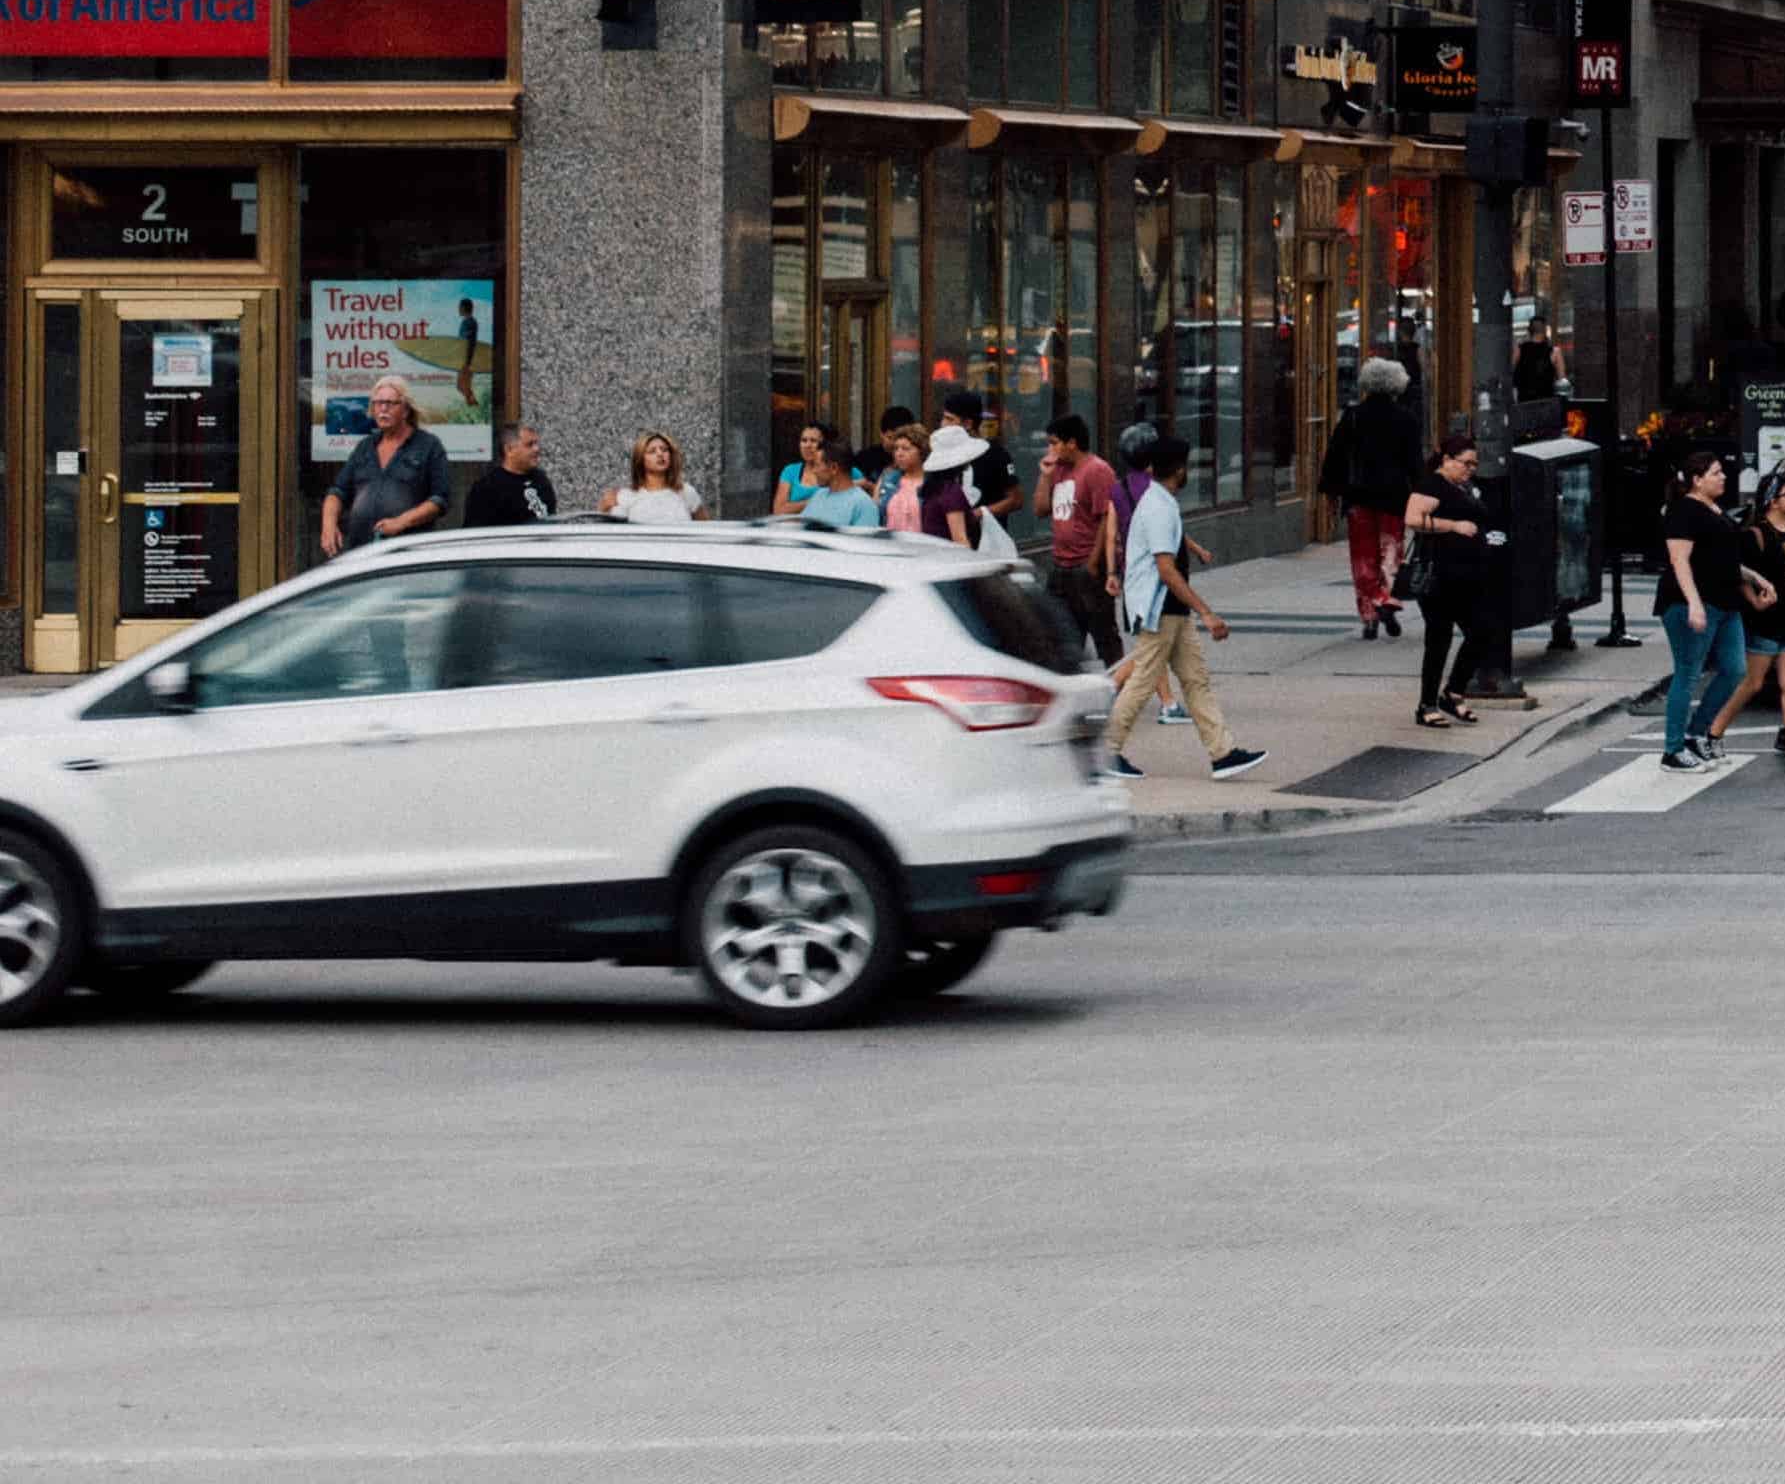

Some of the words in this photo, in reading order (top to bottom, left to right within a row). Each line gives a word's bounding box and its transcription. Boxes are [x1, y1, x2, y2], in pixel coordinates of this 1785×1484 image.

[1404, 70, 1453, 84] Gloria
[1582, 55, 1617, 80] MR
[142, 184, 166, 220] 2
[122, 227, 188, 243] SOUTH
[323, 287, 404, 311] Travel
[325, 316, 430, 340] without
[326, 345, 390, 368] rules
